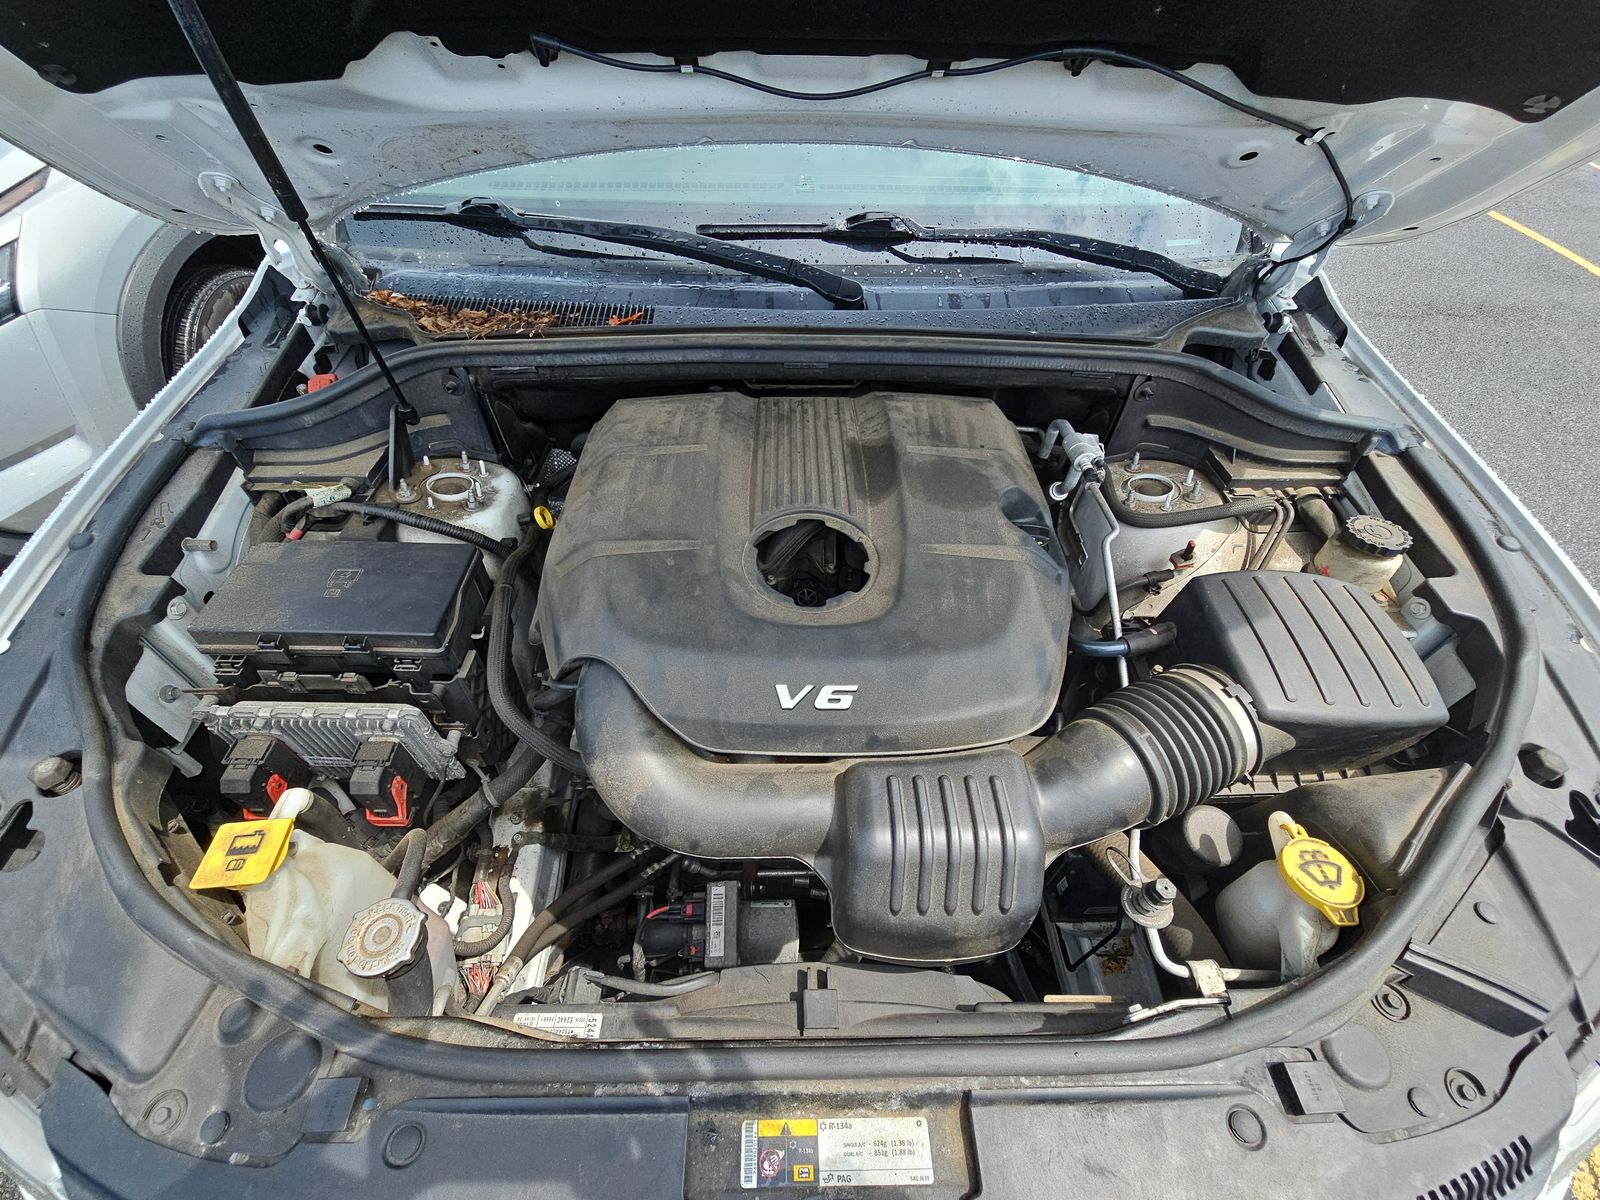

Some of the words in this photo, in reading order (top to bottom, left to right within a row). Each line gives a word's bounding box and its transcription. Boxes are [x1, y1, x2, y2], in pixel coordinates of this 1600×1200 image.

[775, 684, 859, 711] V6
[828, 1121, 852, 1130] R-134a
[873, 1140, 887, 1148] 624g
[891, 1139, 905, 1147] (1.38
[907, 1139, 915, 1147] lb)
[892, 1149, 906, 1157] (1.88
[907, 1148, 915, 1156] lb)
[837, 1174, 852, 1183] PAG
